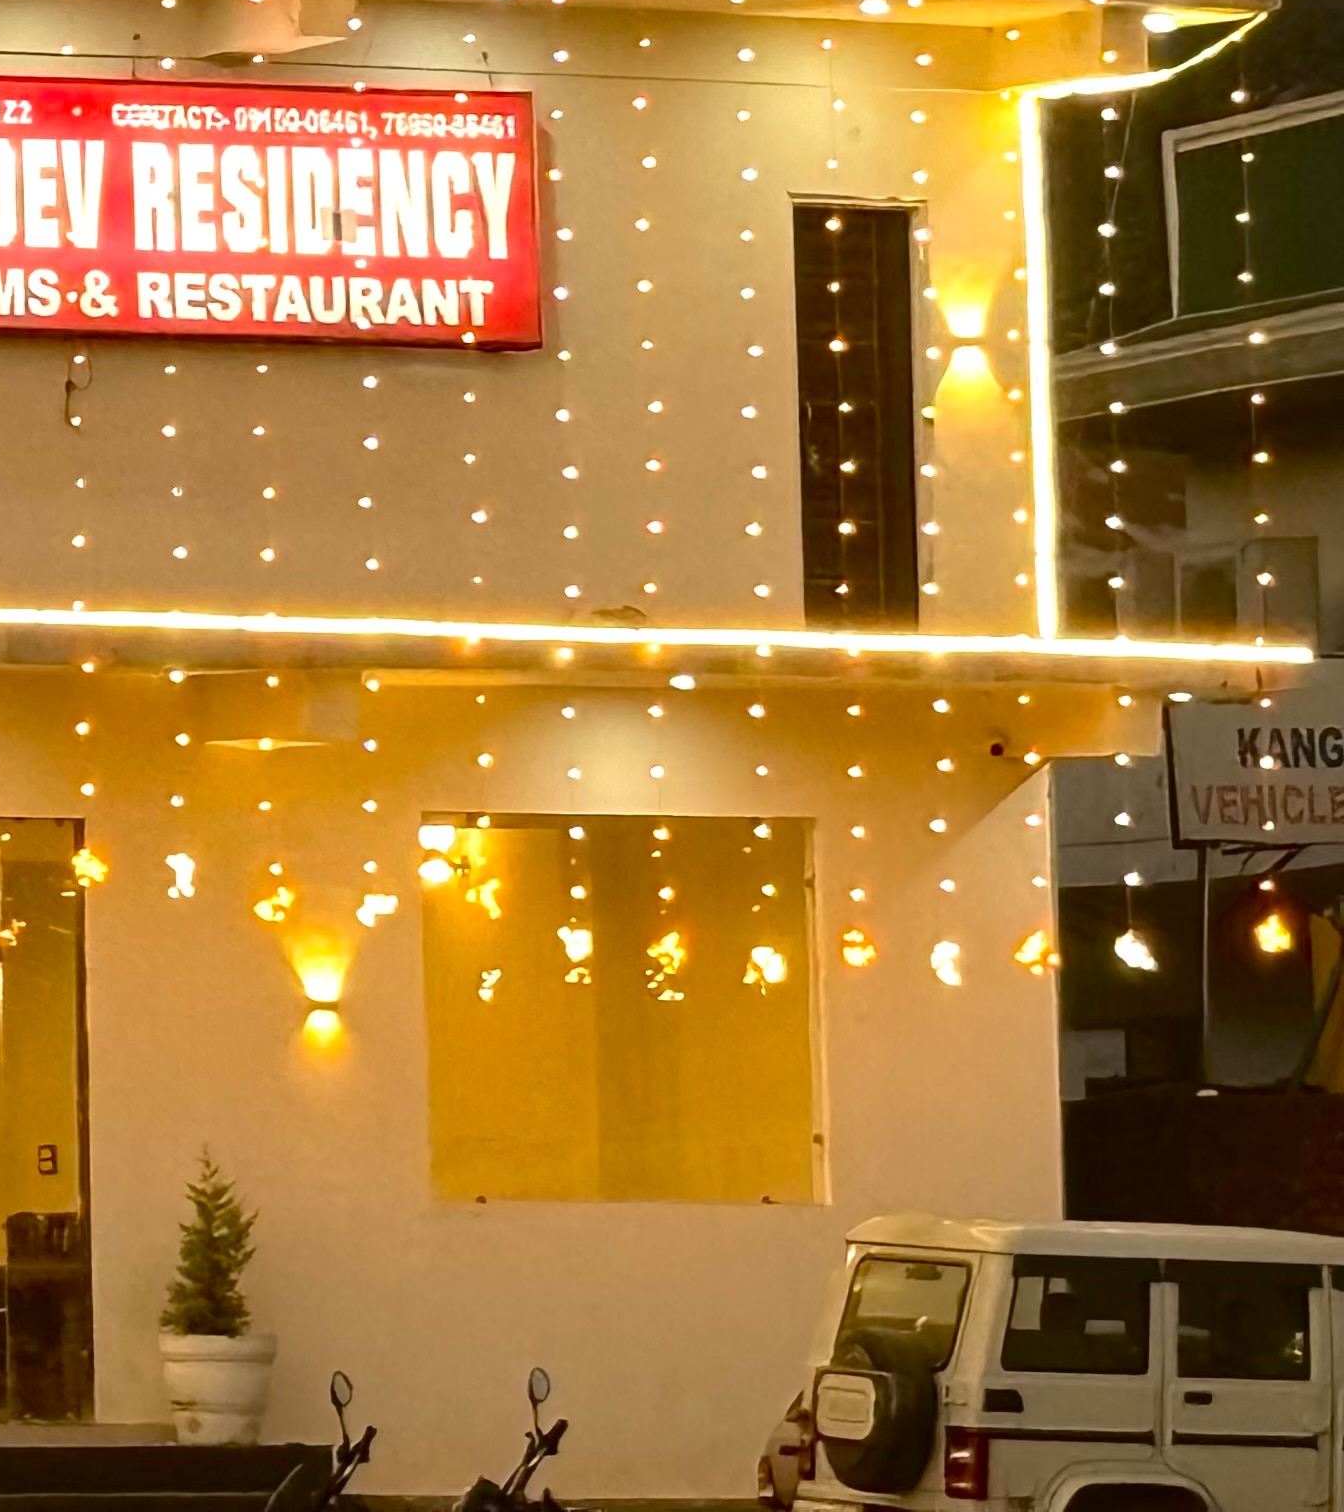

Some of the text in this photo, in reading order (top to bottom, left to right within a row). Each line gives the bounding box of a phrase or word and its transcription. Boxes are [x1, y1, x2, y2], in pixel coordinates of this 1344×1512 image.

[132, 141, 516, 260] RESIDENCY
[79, 270, 118, 318] &
[137, 272, 494, 327] RESTAURANT
